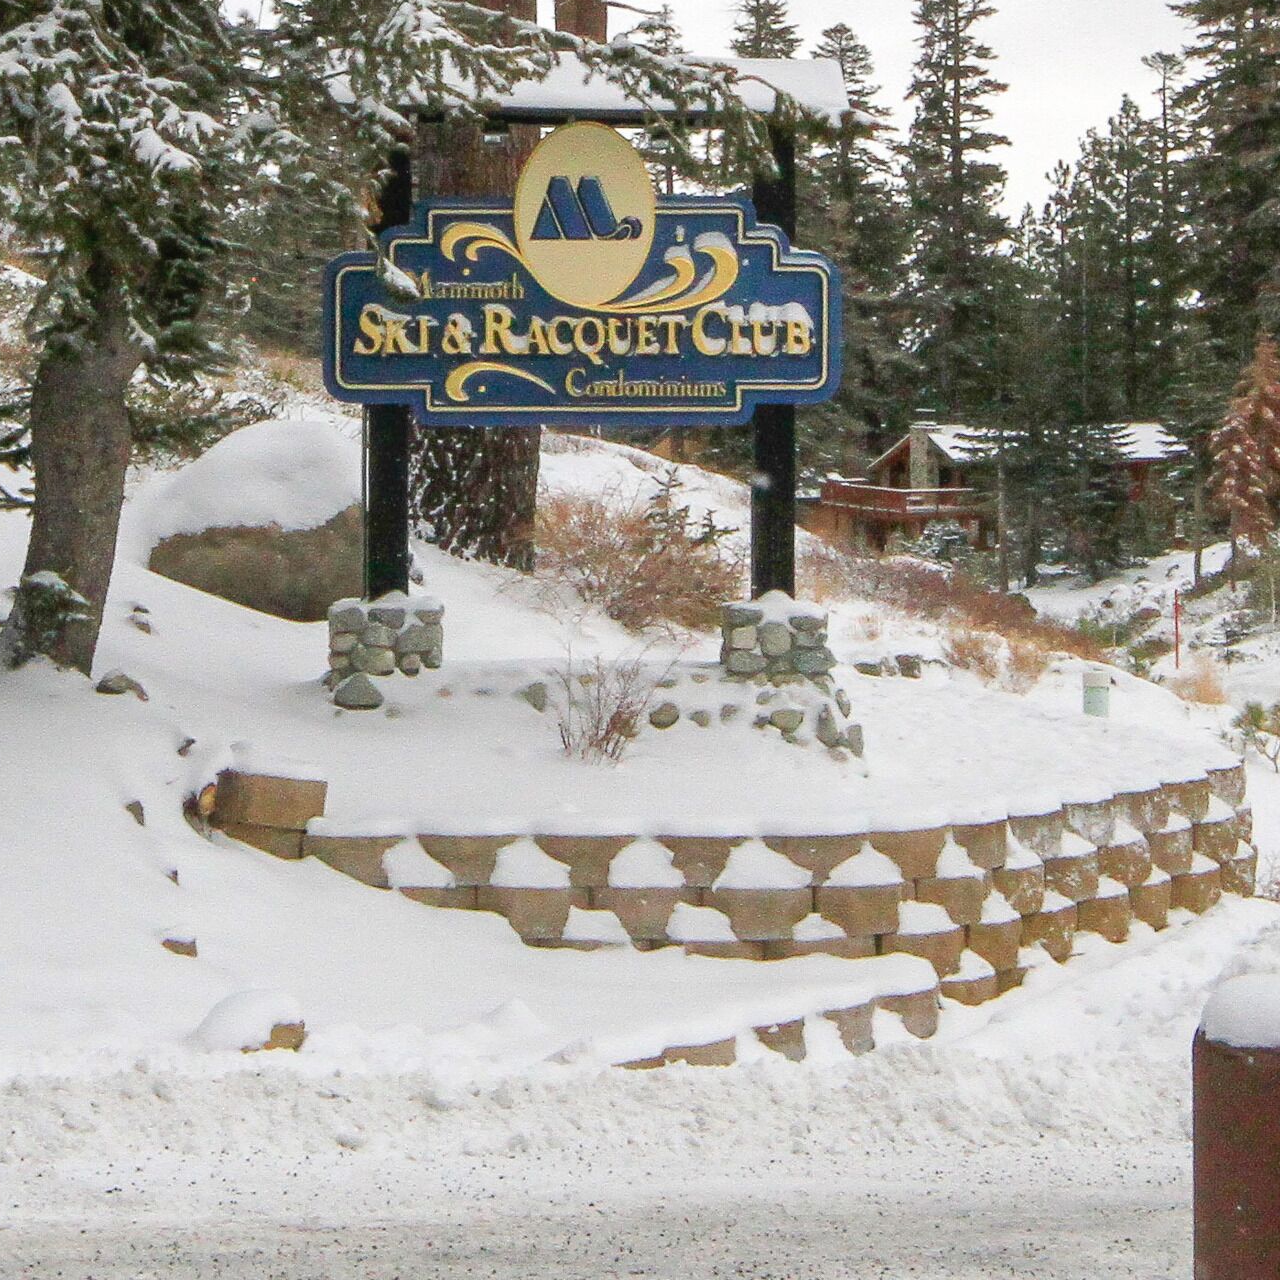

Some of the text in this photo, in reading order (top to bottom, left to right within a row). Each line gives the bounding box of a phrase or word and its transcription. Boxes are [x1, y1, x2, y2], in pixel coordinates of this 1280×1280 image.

[353, 303, 813, 365] SKI & RACQUET CLUB
[565, 368, 727, 397] Condominiums
